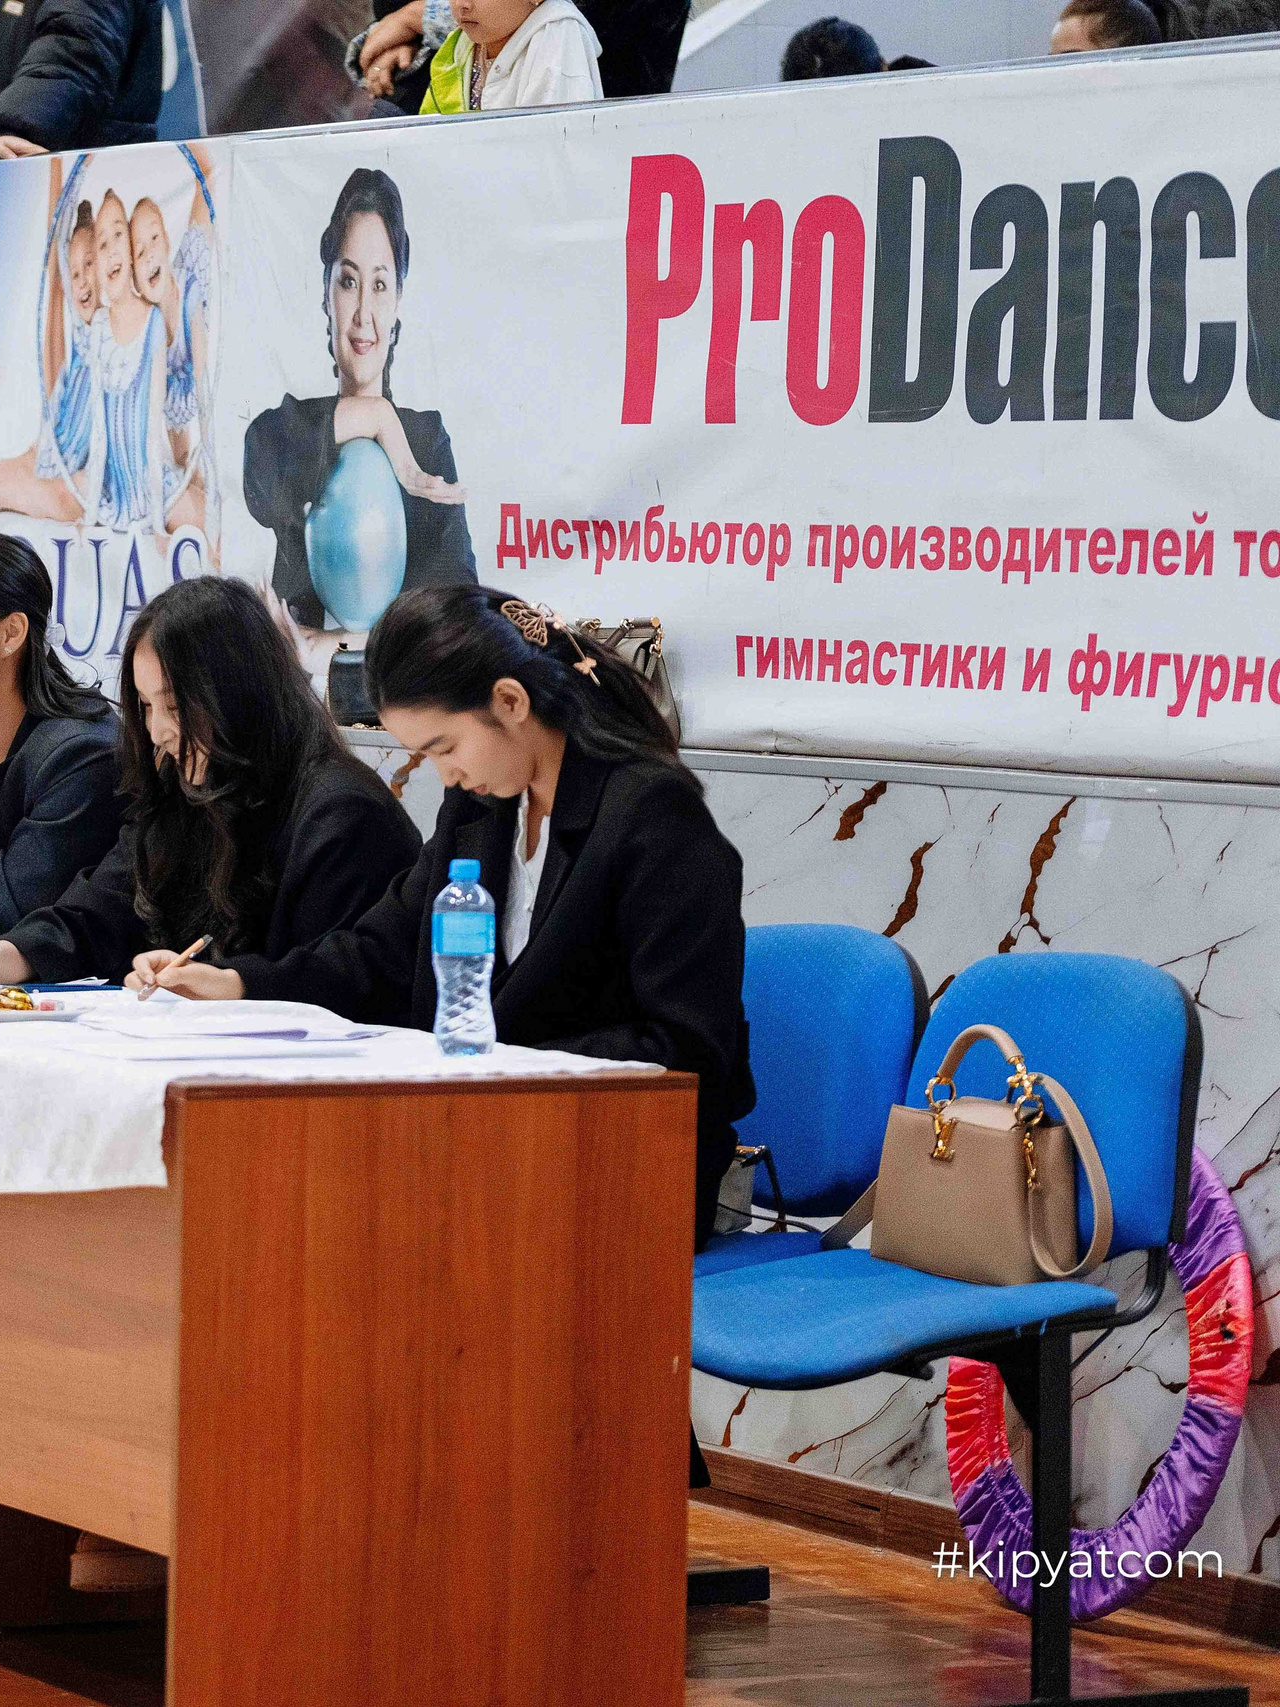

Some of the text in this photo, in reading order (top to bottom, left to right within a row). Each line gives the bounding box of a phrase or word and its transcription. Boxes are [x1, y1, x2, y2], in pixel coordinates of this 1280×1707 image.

[496, 503, 792, 582] Дистрибьютор
[807, 511, 1214, 584] производителей
[735, 635, 1007, 692] гимнастики
[1022, 648, 1052, 693] и
